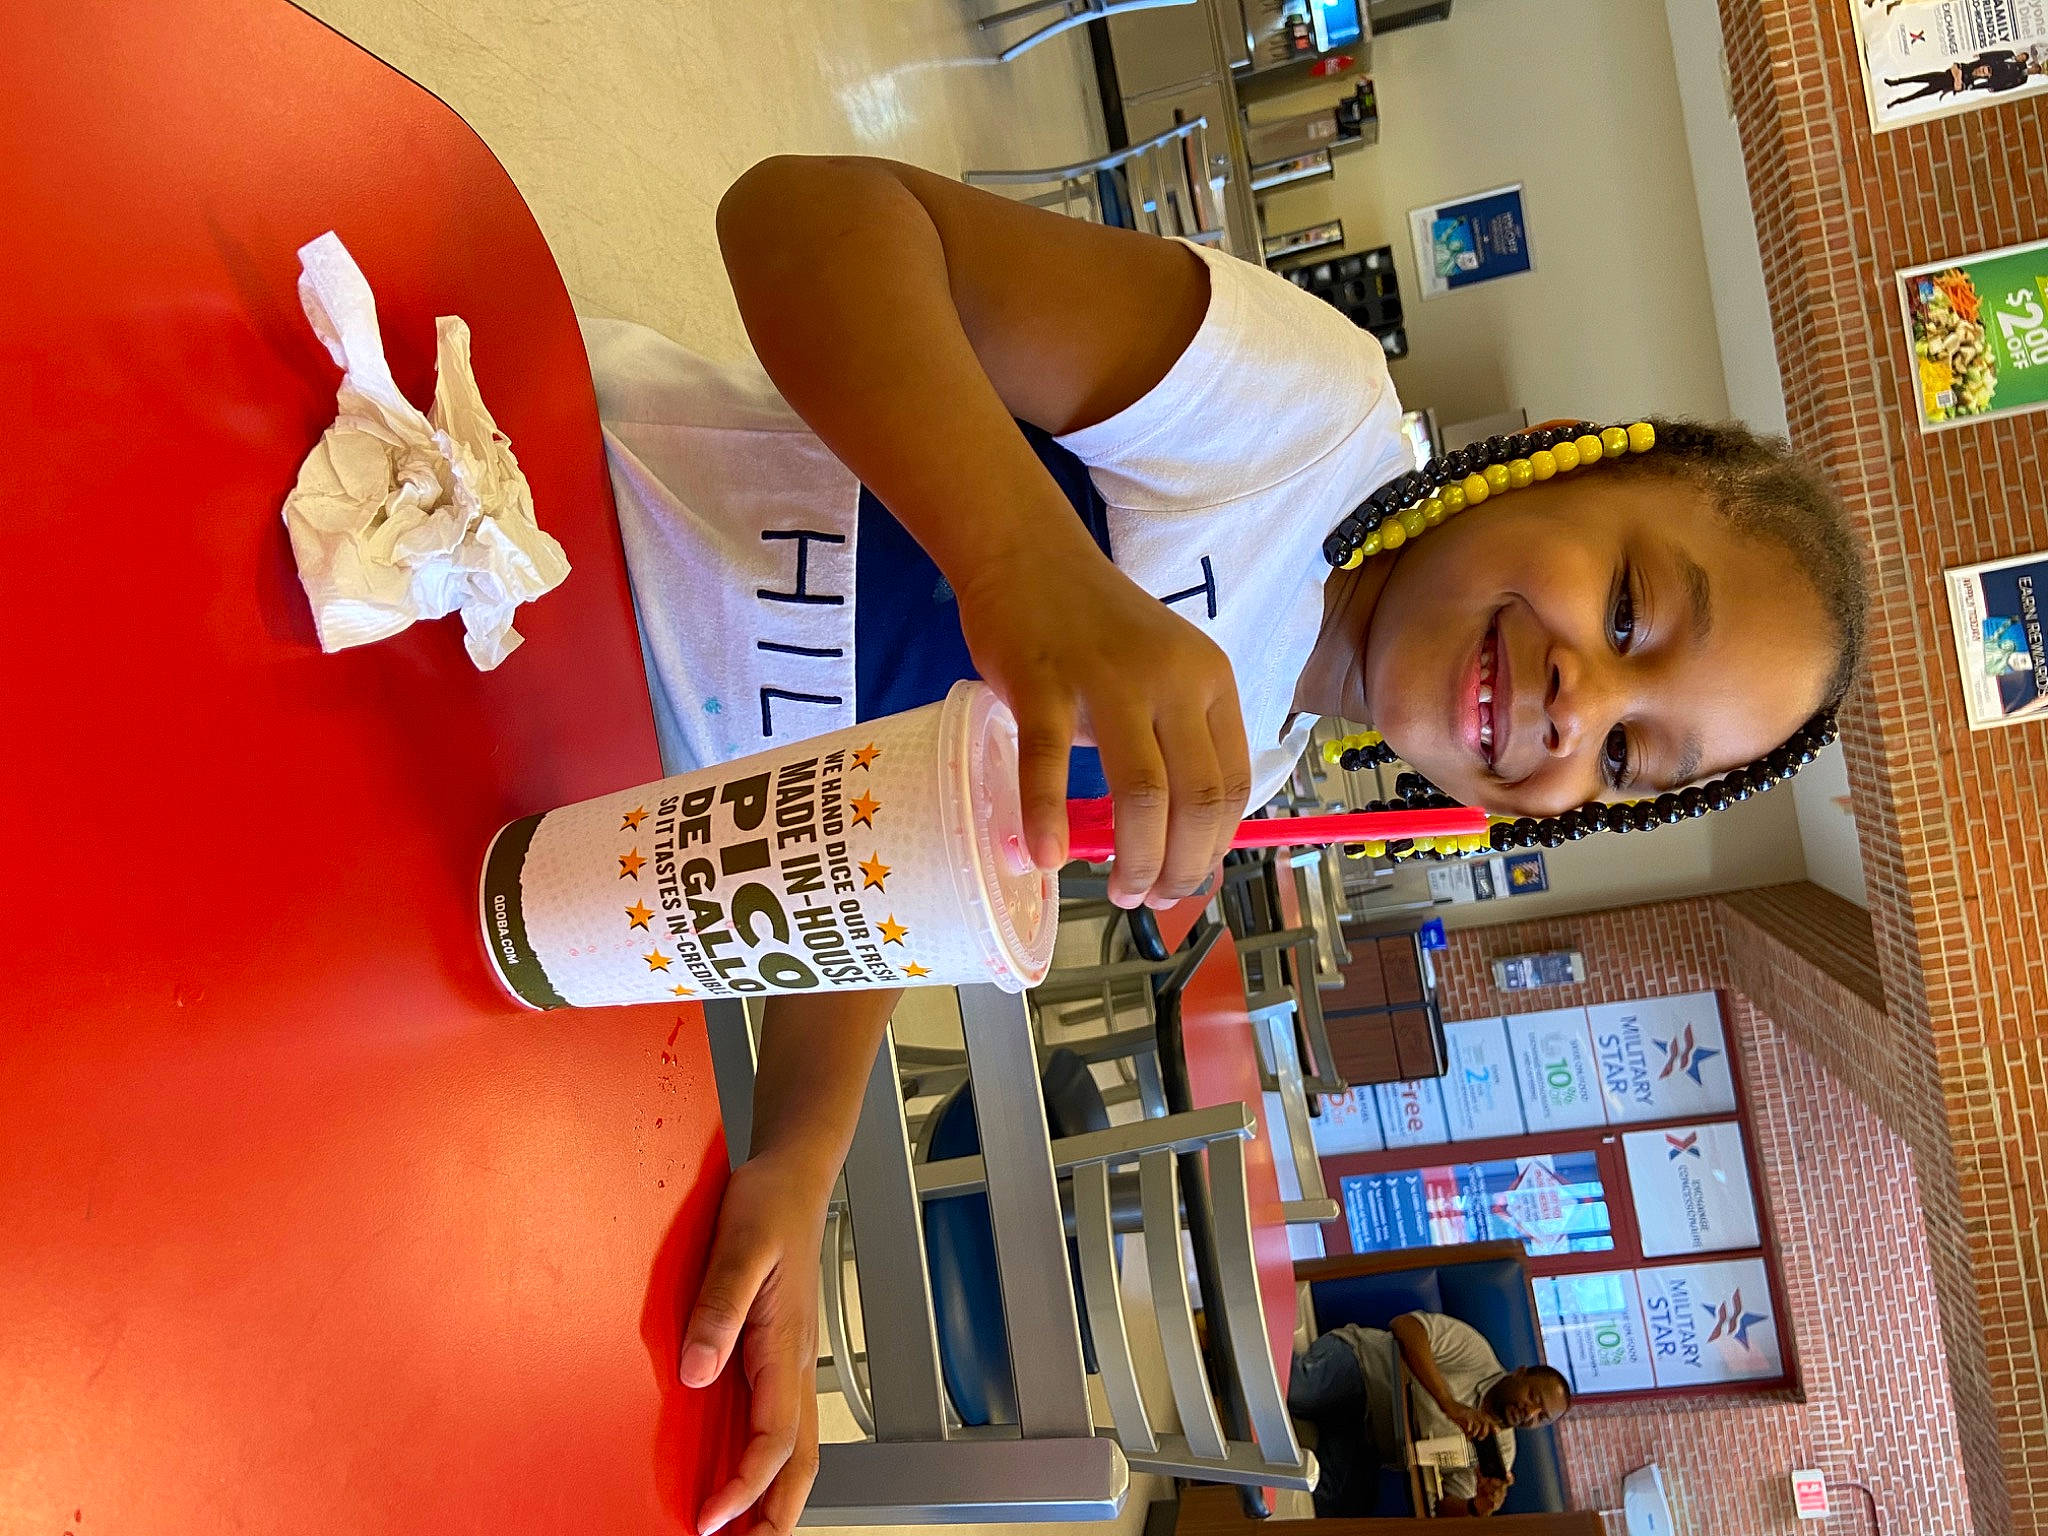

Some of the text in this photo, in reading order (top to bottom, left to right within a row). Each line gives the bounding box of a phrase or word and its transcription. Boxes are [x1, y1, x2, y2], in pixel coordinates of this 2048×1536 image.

[1942, 3, 1958, 56] EXCHANGE
[2006, 337, 2030, 370] OFF
[2018, 576, 2048, 699] EARN REWARDS
[654, 795, 734, 996] SO IT TASTES IN-CREDIBLE
[678, 786, 768, 994] DE GALLO
[720, 772, 820, 990] PICO
[774, 758, 874, 986] MADE IN-HOUSE
[821, 749, 900, 982] WE HAND DICE OUR FRESH
[494, 894, 520, 964] QDOBA.COM
[1465, 1066, 1490, 1084] 2
[1598, 1034, 1628, 1094] STAR
[1620, 1015, 1654, 1106] MILITARY
[1400, 1080, 1424, 1132] Free
[1648, 1296, 1676, 1356] STAR
[1669, 1279, 1702, 1368] MILITARY
[1797, 1481, 1826, 1512] EXIT
